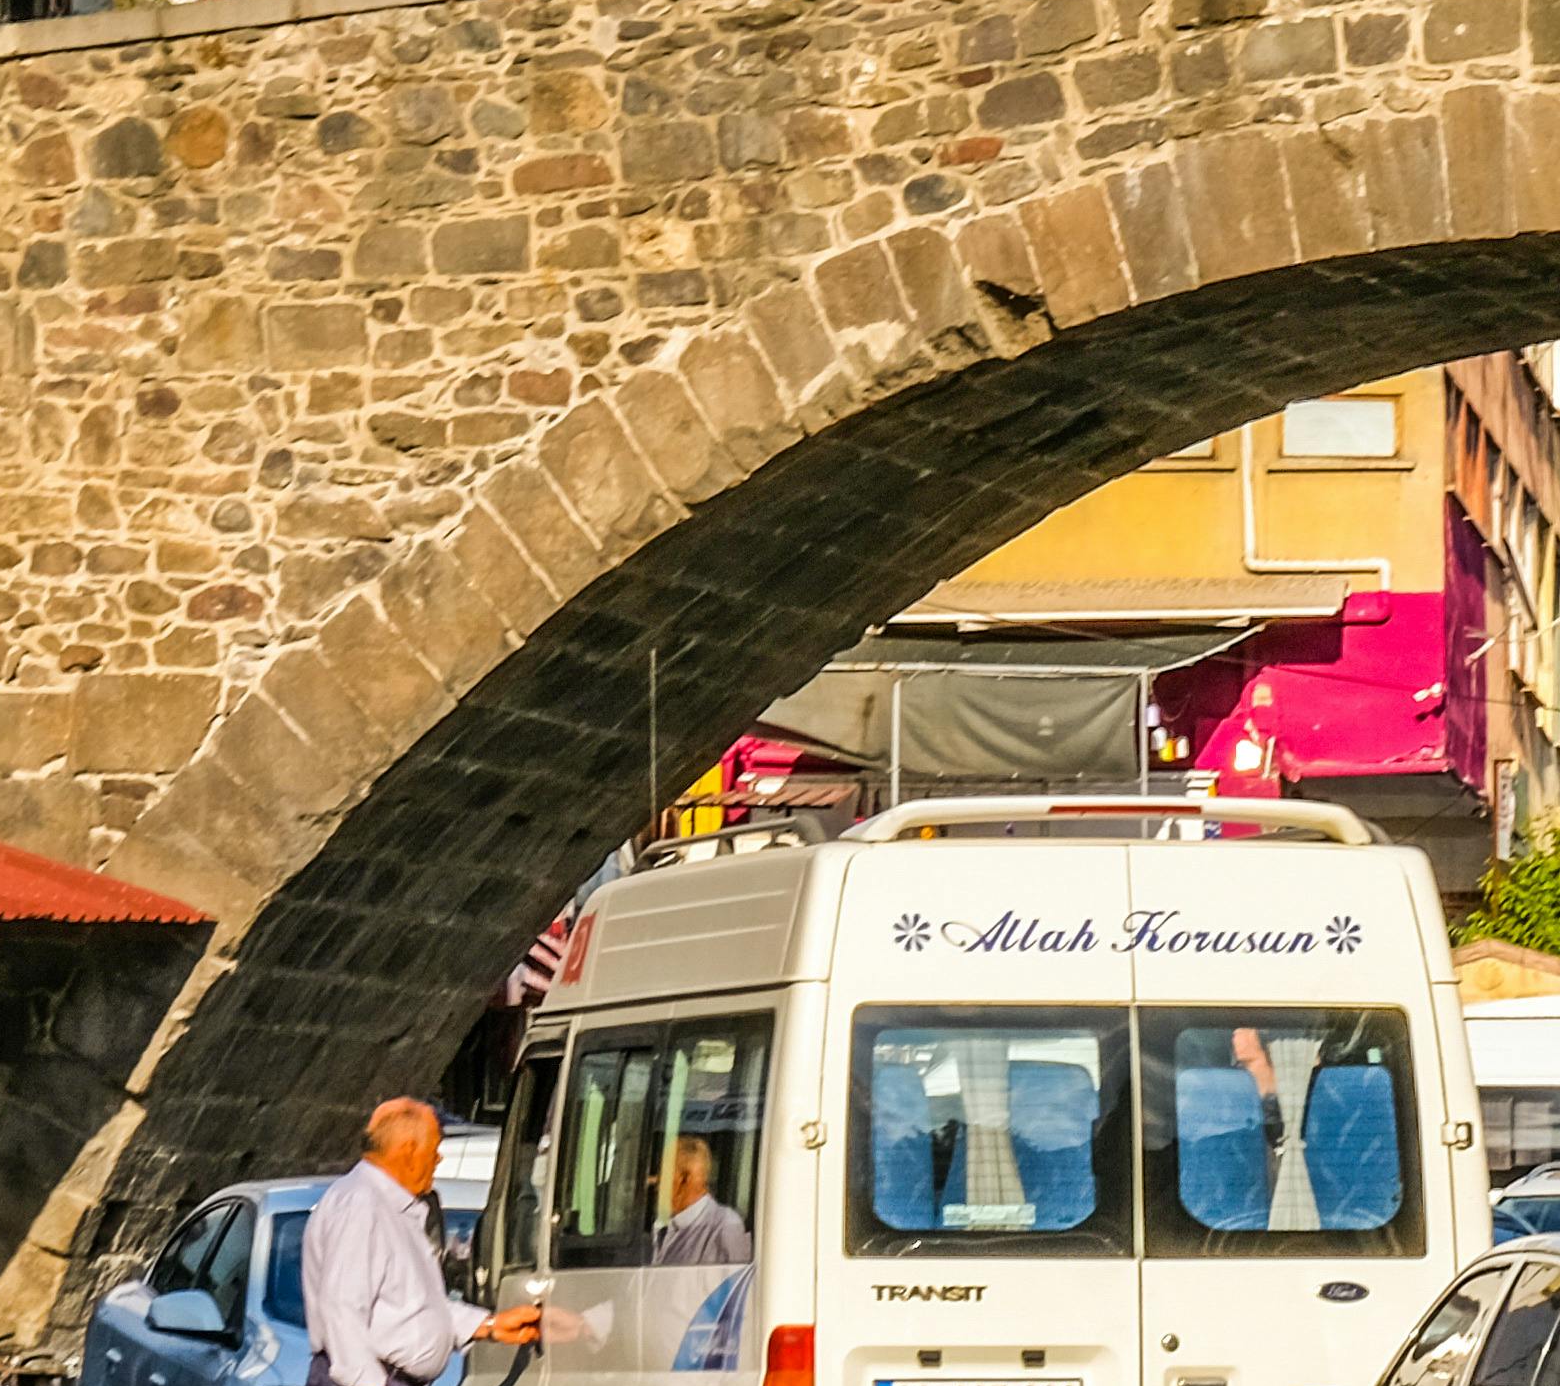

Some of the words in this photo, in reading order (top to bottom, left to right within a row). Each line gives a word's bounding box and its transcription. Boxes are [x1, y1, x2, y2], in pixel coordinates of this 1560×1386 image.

[941, 909, 1100, 953] Allah
[1111, 909, 1322, 954] Korusun
[871, 1284, 988, 1302] TRANSIT
